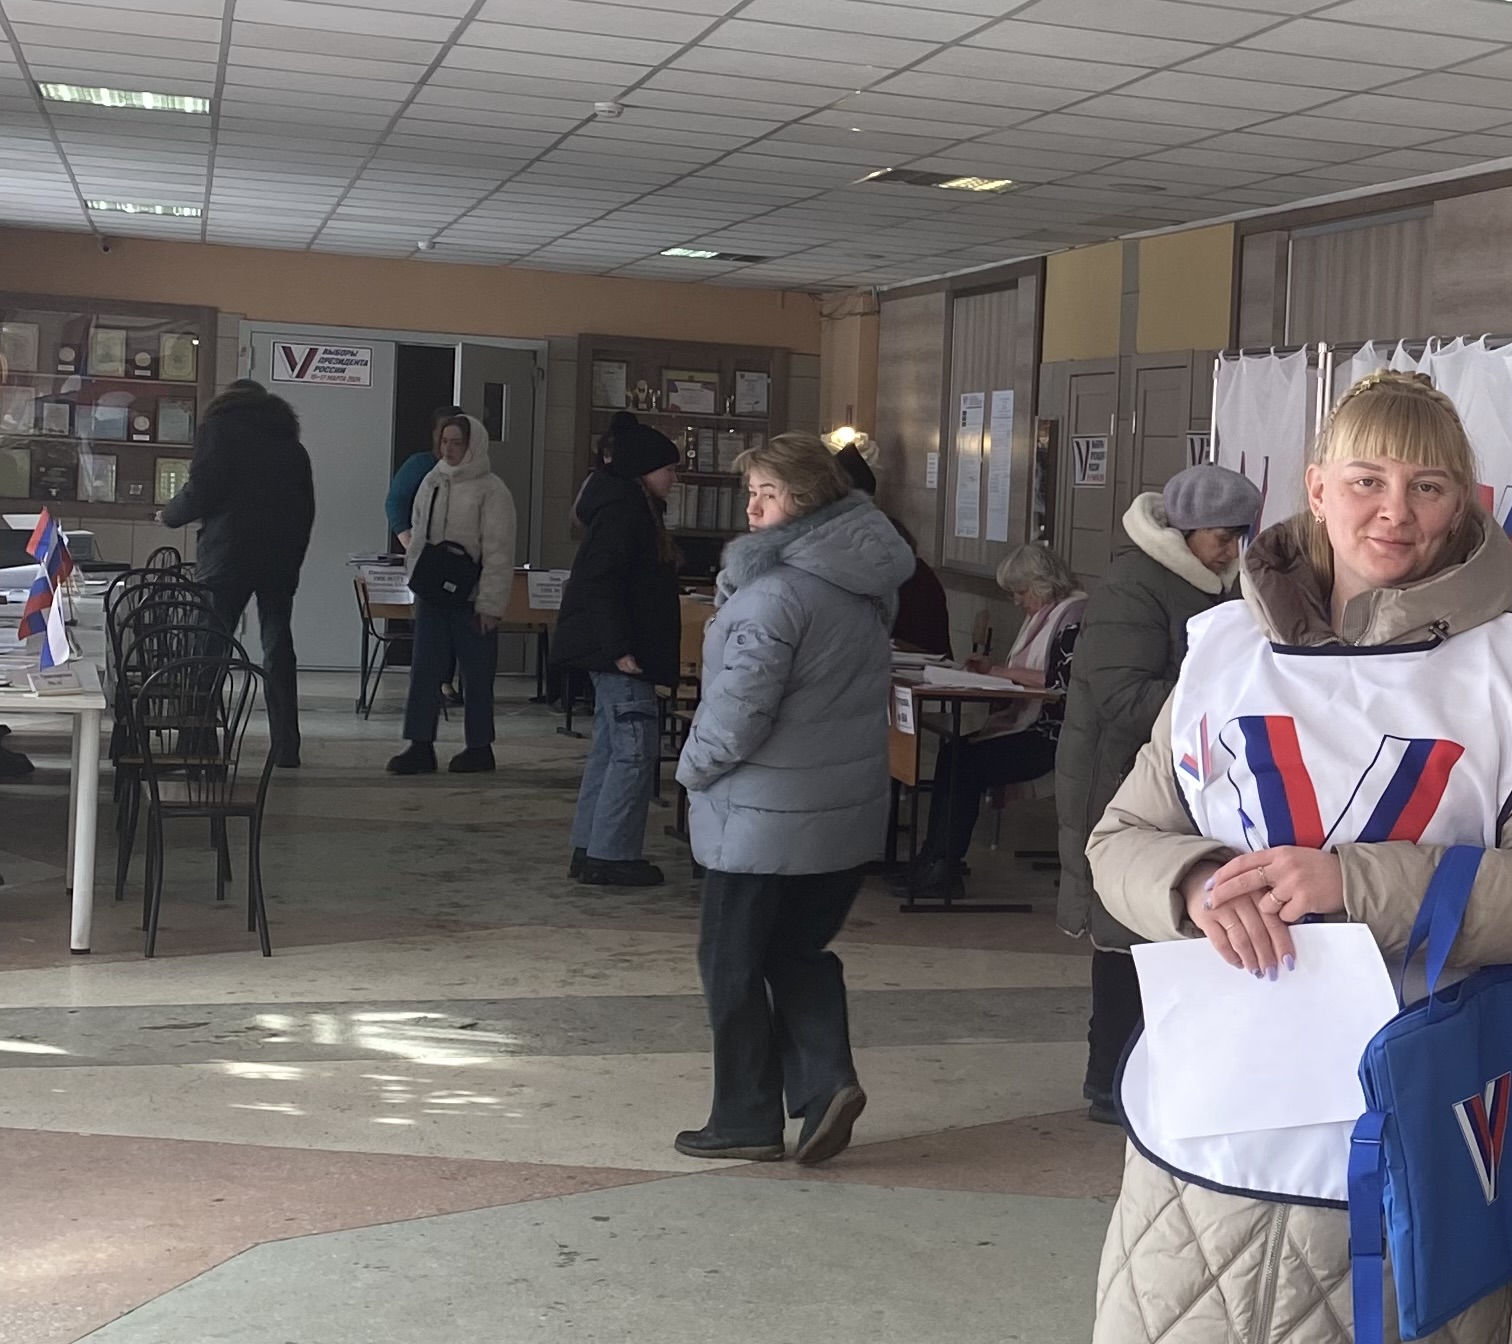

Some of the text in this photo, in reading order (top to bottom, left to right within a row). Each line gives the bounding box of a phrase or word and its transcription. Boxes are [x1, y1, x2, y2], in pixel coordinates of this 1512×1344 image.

[322, 348, 359, 357] ВЫБОРЫ
[318, 357, 369, 367] ПРЕЗИДЕНТА
[313, 366, 347, 374] РОССИИ
